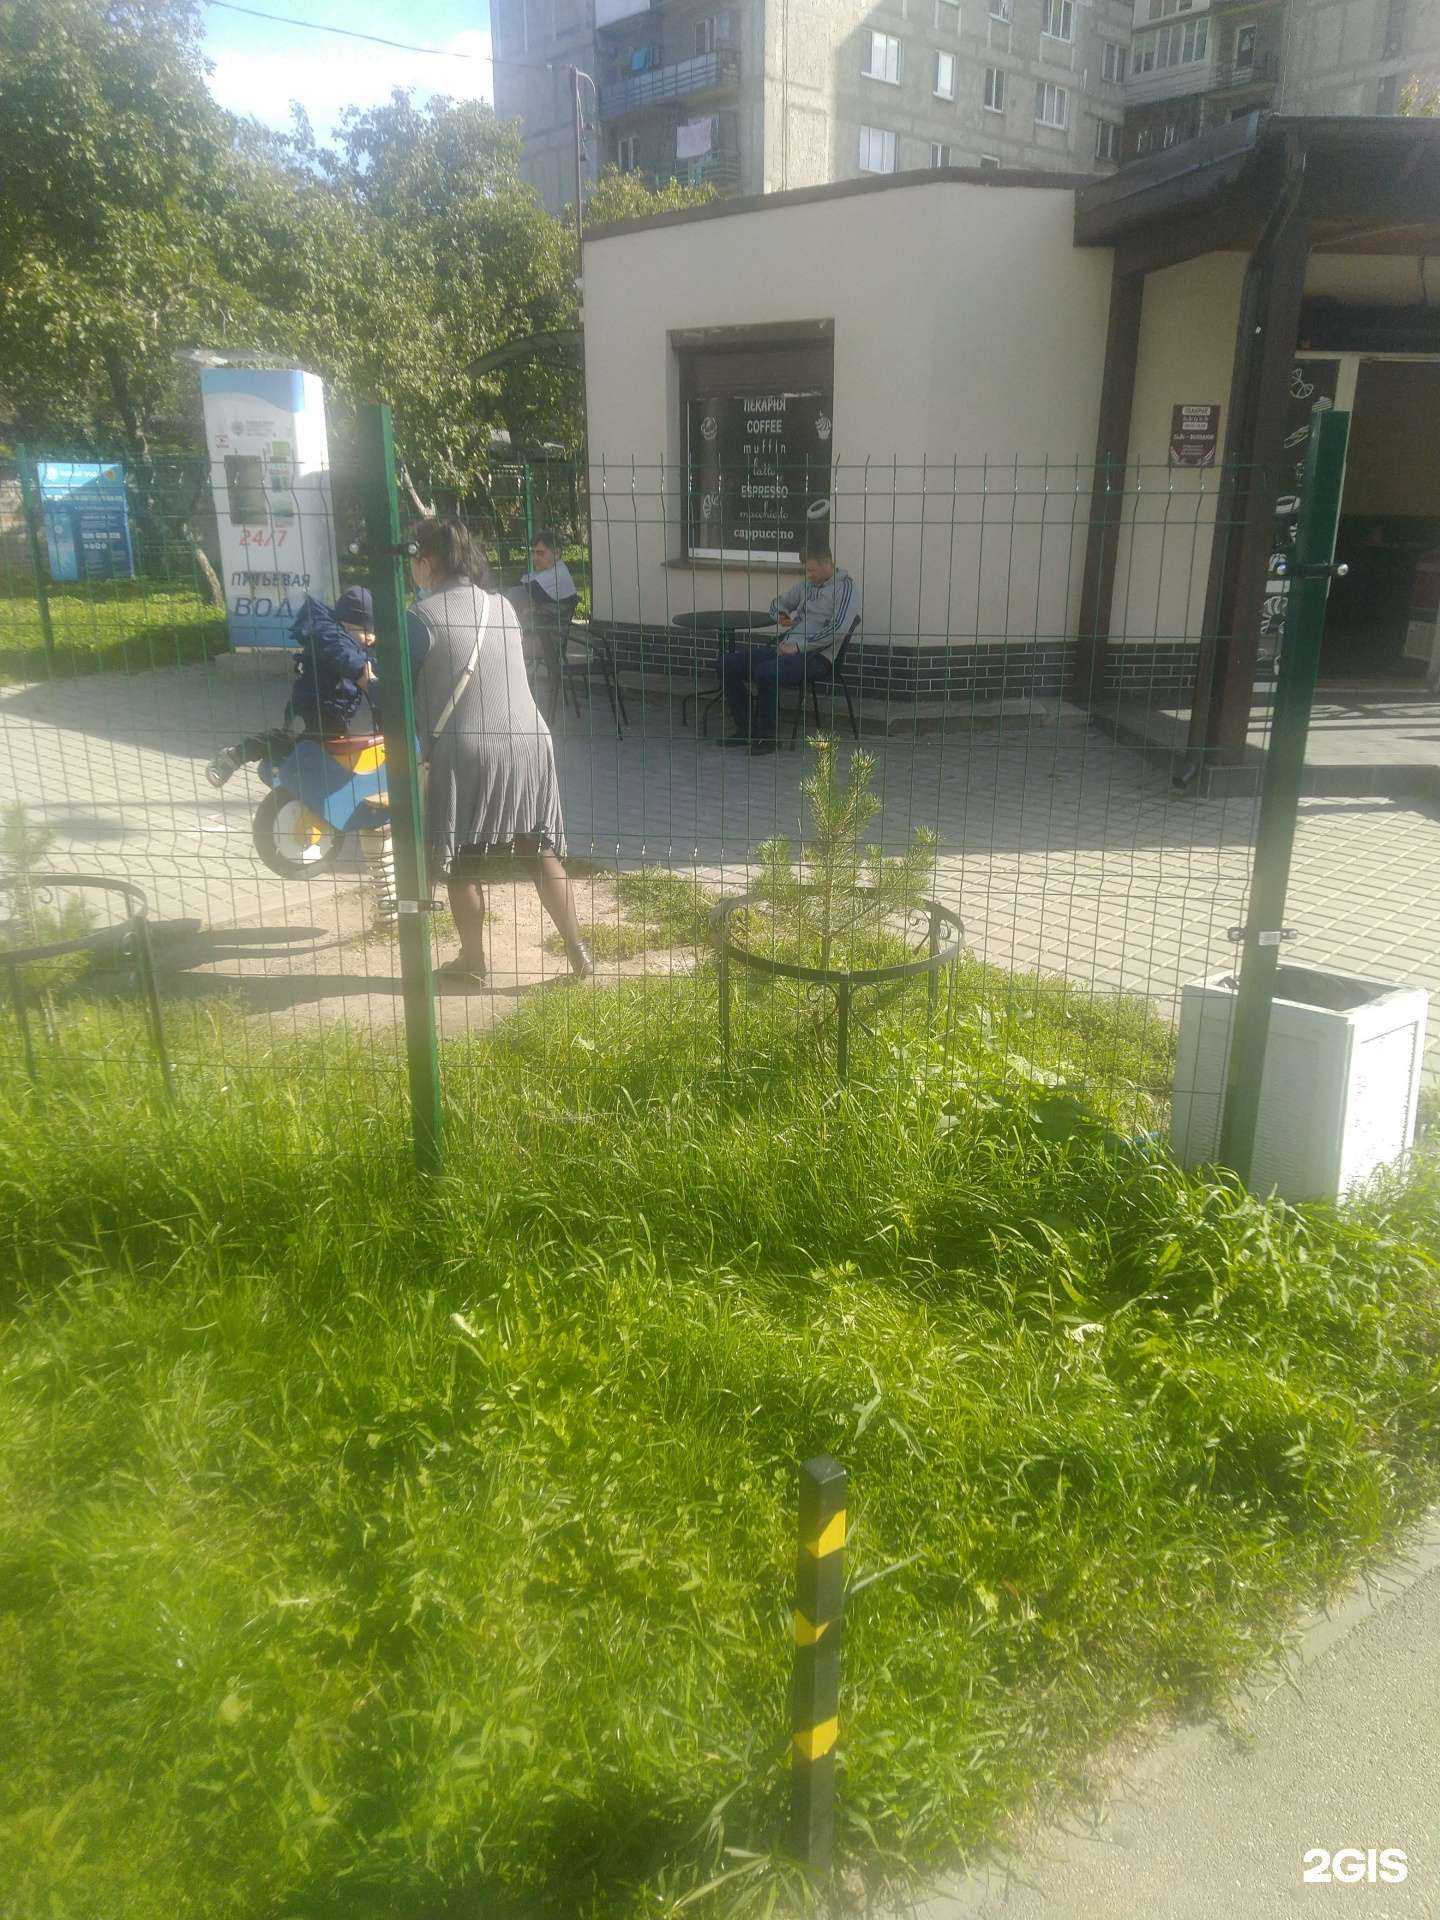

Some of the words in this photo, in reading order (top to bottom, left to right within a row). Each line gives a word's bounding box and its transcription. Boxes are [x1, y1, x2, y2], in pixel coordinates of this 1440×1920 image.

[747, 419, 782, 434] COFFEE
[743, 438, 786, 455] muffin
[741, 484, 789, 499] ESPRESSO
[239, 528, 287, 547] 24/7
[234, 597, 296, 618] ВОД
